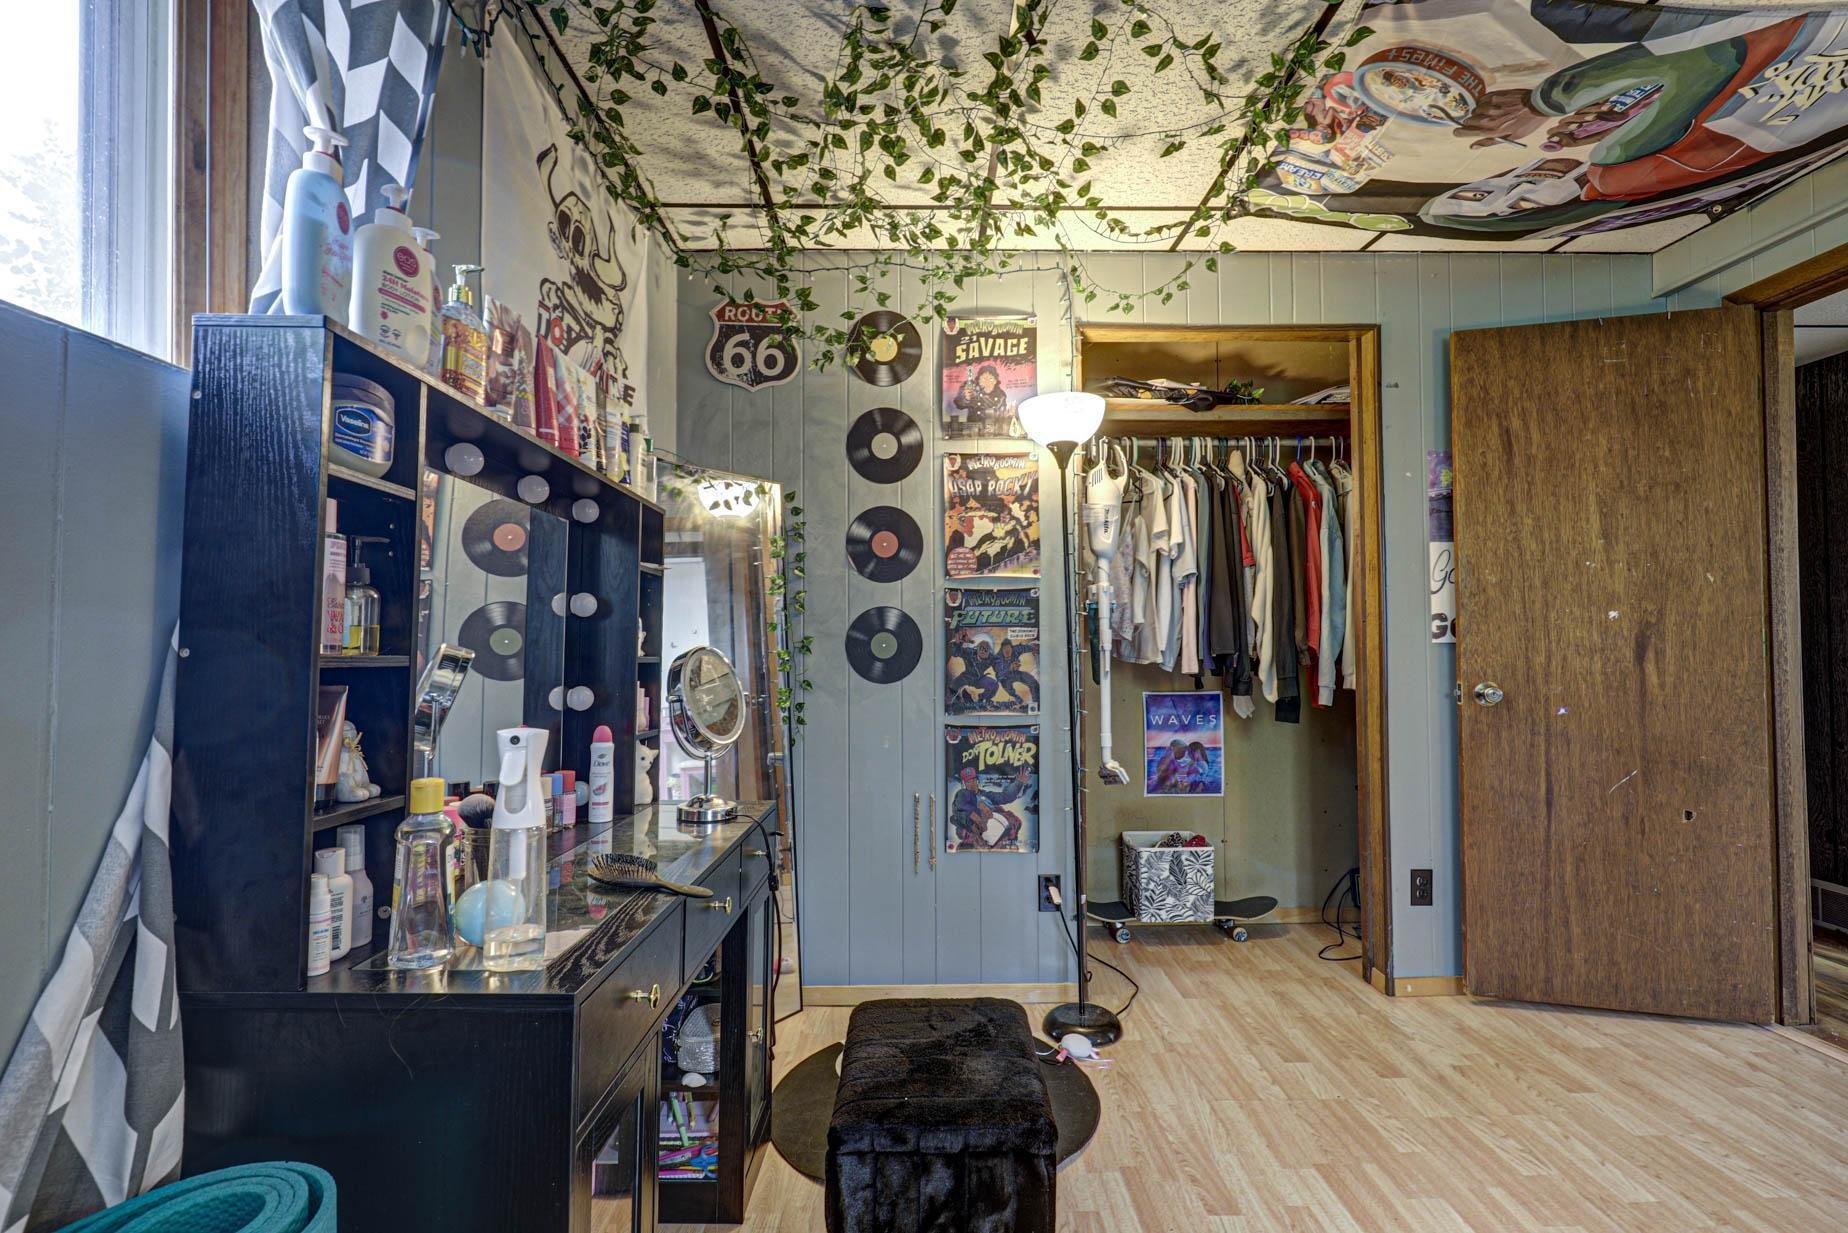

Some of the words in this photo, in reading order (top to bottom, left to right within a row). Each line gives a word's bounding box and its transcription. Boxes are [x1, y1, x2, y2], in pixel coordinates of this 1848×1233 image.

[1460, 70, 1482, 98] THE
[724, 306, 784, 321] ROUT
[723, 333, 784, 377] 66
[955, 337, 1029, 364] SAVAGE
[949, 609, 1036, 630] FUTURE
[1150, 714, 1217, 726] WAVES
